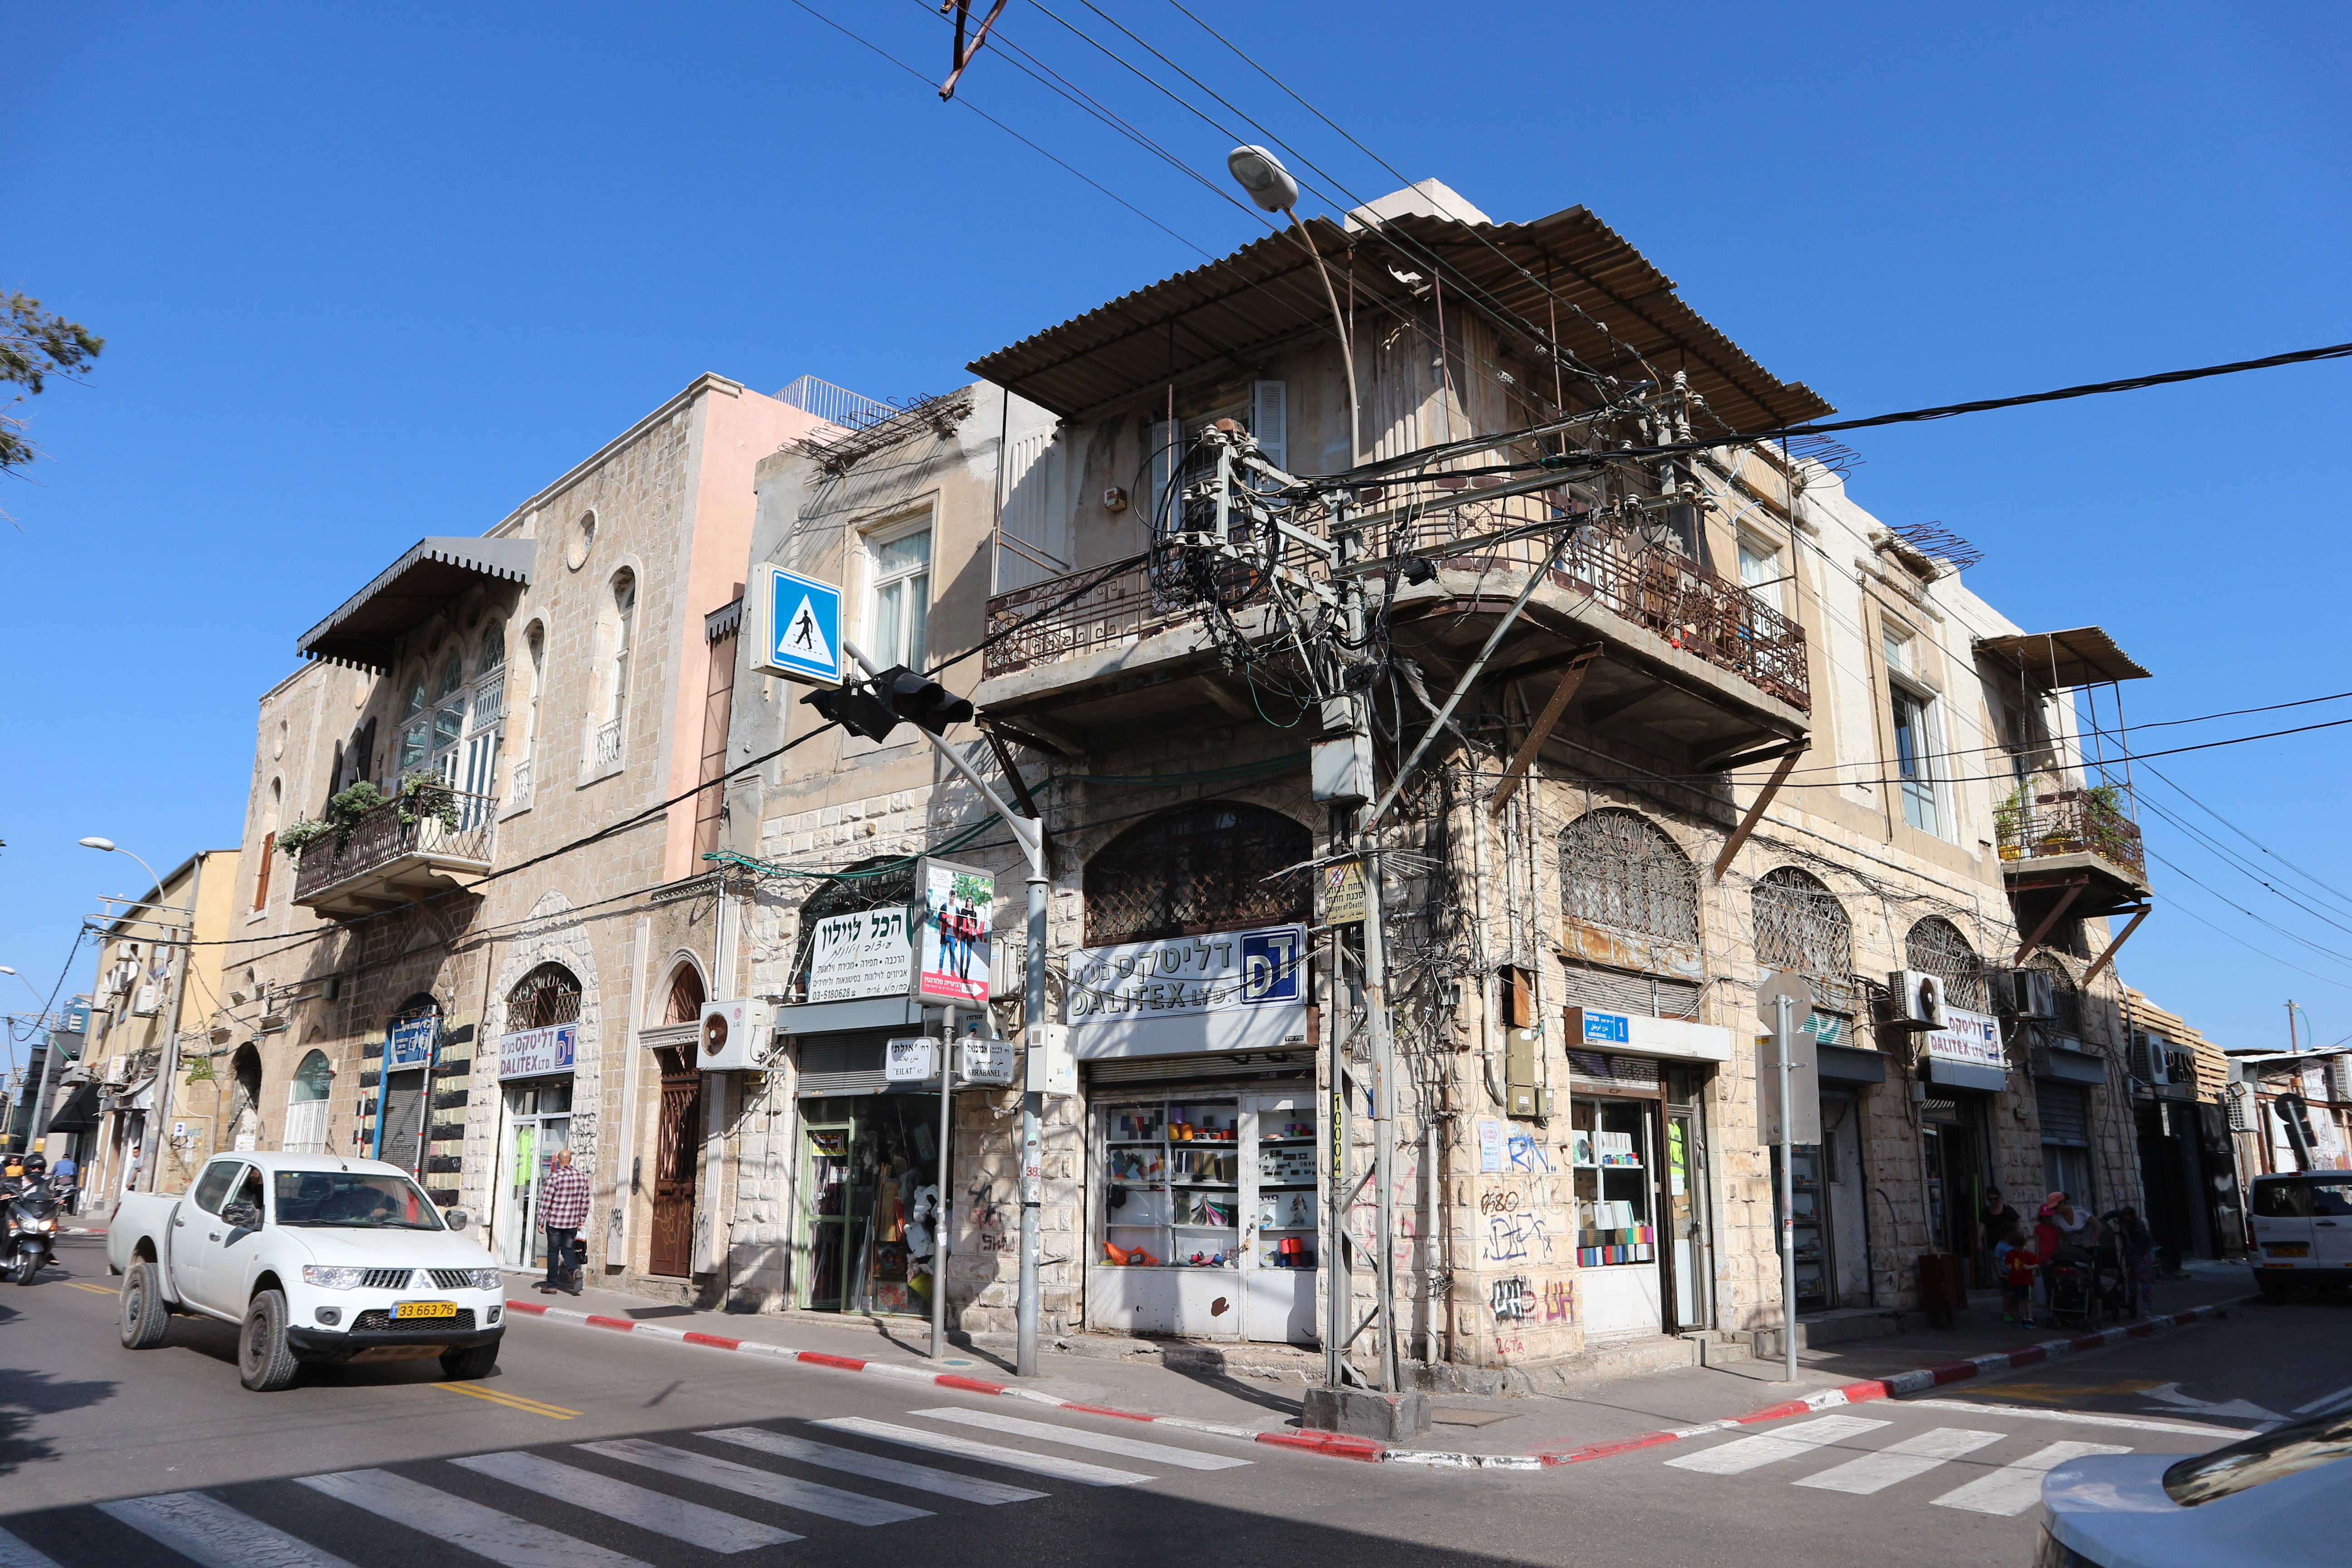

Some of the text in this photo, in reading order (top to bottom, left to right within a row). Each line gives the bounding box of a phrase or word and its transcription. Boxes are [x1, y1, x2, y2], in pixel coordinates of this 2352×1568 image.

[1348, 882, 1362, 891] מתח
[1347, 892, 1363, 900] סכנת
[1349, 900, 1364, 909] Death!
[822, 911, 901, 952] הכל לוילון
[864, 941, 892, 952] עיצוב
[860, 958, 877, 968] תפירה
[885, 955, 905, 965] הרכבה
[1115, 938, 1232, 984] דליטקס
[838, 962, 854, 971] מכירת
[813, 969, 907, 987] אביזרים לוילונות בסיטונאות וליחידים
[924, 976, 943, 985] פלורנטין
[813, 988, 850, 1000] 03-5180628
[1071, 982, 1231, 1016] DALITEX LTD.
[1619, 1022, 1624, 1037] 1
[1949, 1016, 1982, 1036] דליטקס
[515, 1029, 554, 1055] דליטקס
[1931, 1034, 1970, 1056] DALITEX
[967, 1043, 988, 1054] אברבנאל
[500, 1055, 551, 1075] DALITEX LTD.
[893, 1067, 916, 1075] "EILAT"
[967, 1069, 1001, 1077] ABRABANEL
[1333, 1096, 1342, 1175] 10004
[1496, 1337, 1525, 1355] 26TA
